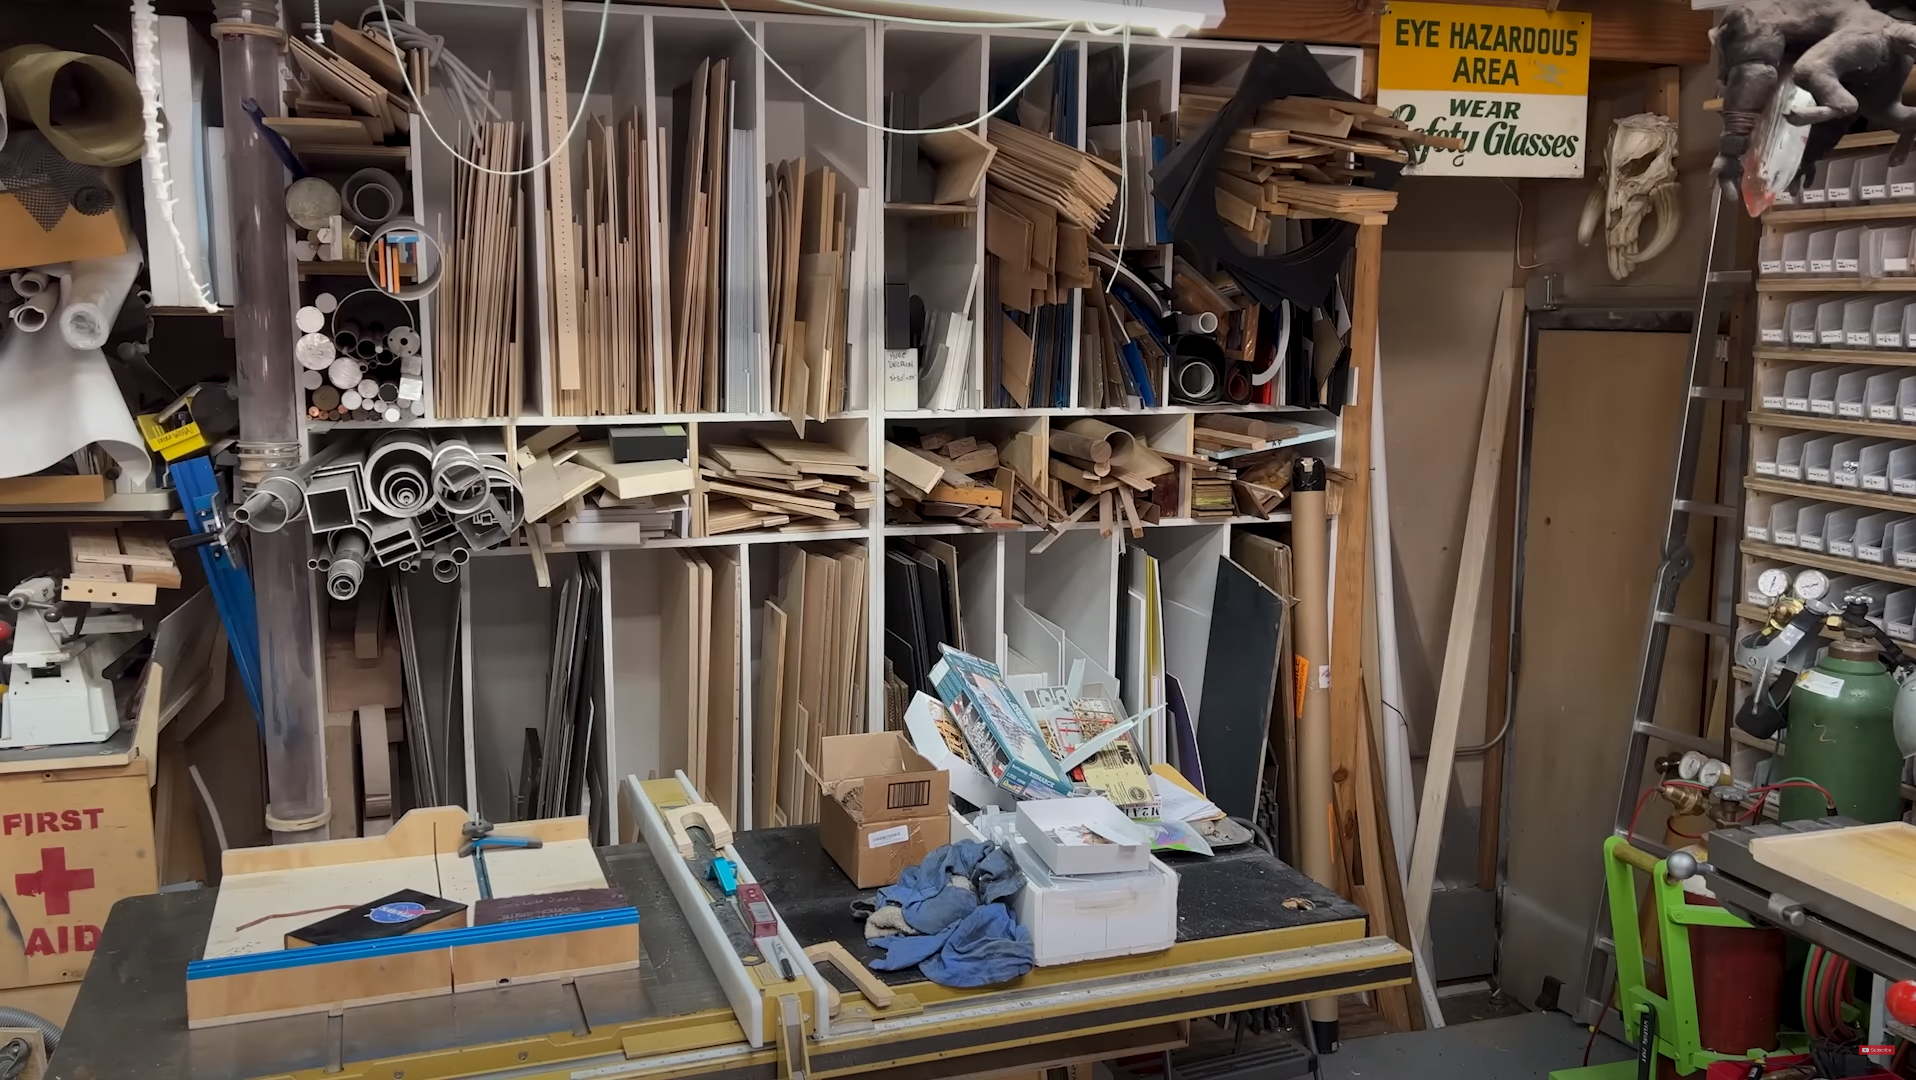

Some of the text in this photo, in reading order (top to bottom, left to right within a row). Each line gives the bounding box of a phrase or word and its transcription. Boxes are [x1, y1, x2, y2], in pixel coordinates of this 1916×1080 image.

[1395, 19, 1578, 56] EYE HAZARDOUS
[1452, 57, 1519, 86] AREA
[1450, 99, 1521, 119] WEAR
[1483, 121, 1579, 158] Glasses
[1117, 744, 1135, 765] 3M
[1029, 771, 1055, 788] BISMARCK
[3, 808, 104, 836] FIRST
[24, 925, 101, 957] AID
